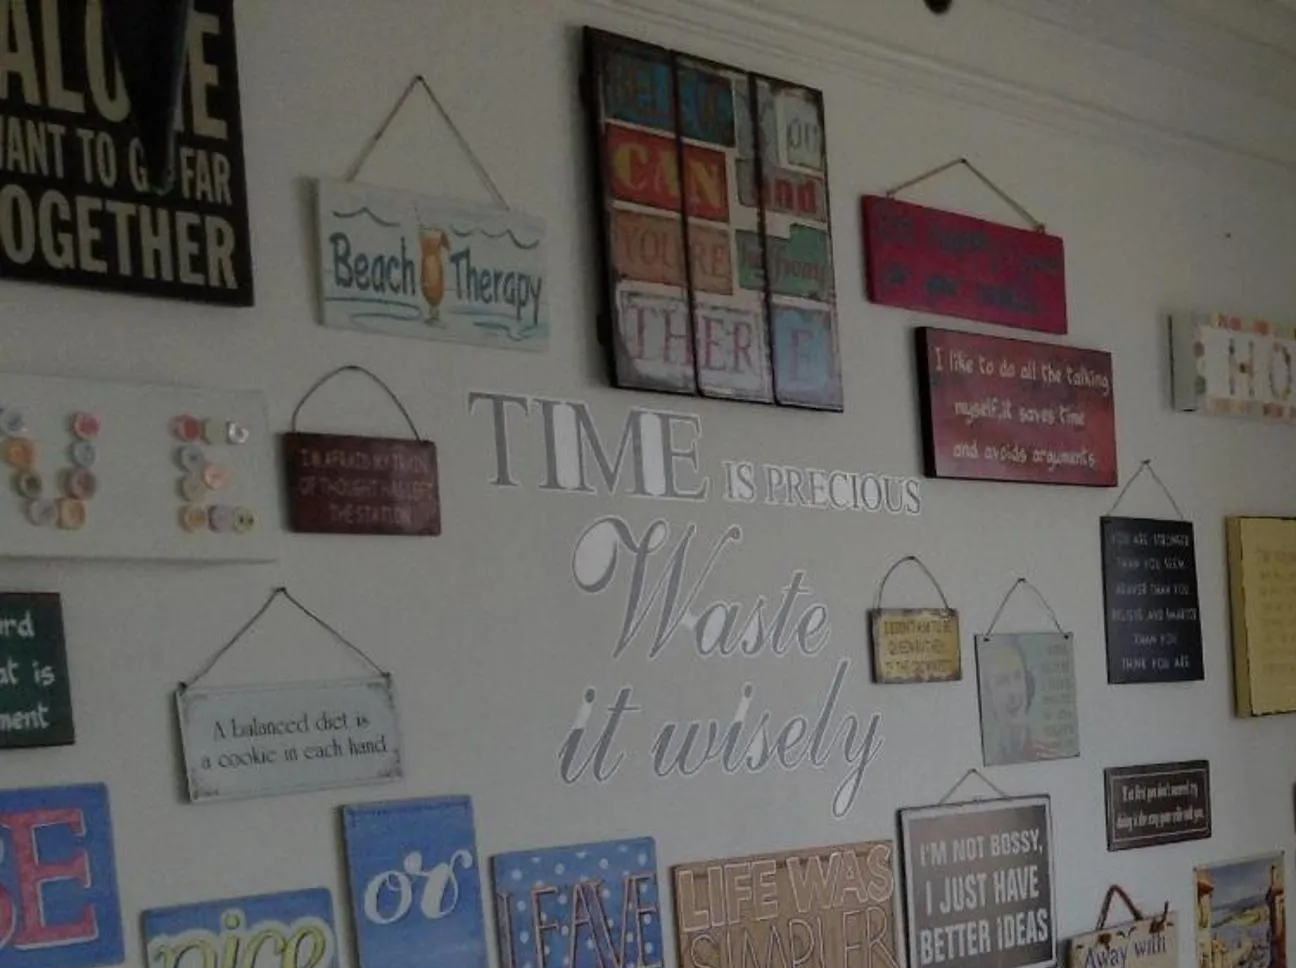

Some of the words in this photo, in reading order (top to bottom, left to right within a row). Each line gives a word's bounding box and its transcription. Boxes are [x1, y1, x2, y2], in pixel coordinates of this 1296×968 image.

[0, 0, 228, 141] ALOE
[0, 113, 66, 179] ANT
[76, 127, 118, 189] TO
[179, 146, 233, 206] FAR
[612, 142, 726, 212] CAN
[329, 232, 416, 297] Beach
[450, 247, 543, 326] Therapy
[934, 347, 944, 372] I
[949, 350, 974, 374] like
[978, 355, 995, 377] to
[1000, 359, 1016, 378] do
[1020, 360, 1037, 381] all
[1041, 364, 1062, 384] the
[1066, 365, 1112, 396] talking
[1018, 405, 1055, 426] saves
[1059, 405, 1086, 427] time
[467, 391, 710, 501] TIME
[721, 460, 755, 502] IS
[762, 463, 922, 515] PRECIOUS
[952, 440, 980, 460] and
[984, 442, 1028, 464] avoids
[1032, 446, 1097, 471] arguments
[571, 514, 832, 662] Waste
[32, 659, 55, 686] is
[201, 757, 212, 770] a
[217, 747, 277, 768] cookie
[284, 747, 299, 762] in
[303, 738, 343, 760] each
[348, 734, 387, 756] hand
[213, 720, 227, 741] A
[231, 713, 309, 738] balanced
[315, 711, 348, 731] diet
[356, 712, 371, 729] is
[558, 687, 642, 786] it
[650, 659, 885, 818] wisely
[0, 807, 99, 950] E
[919, 840, 948, 868] I'M
[952, 834, 986, 863] NOT
[363, 850, 474, 925] or
[678, 858, 779, 933] LIFE
[784, 843, 895, 914] WAS
[925, 880, 933, 917] I
[939, 872, 988, 915] JUST
[993, 864, 1040, 905] HAVE
[918, 919, 992, 967] BETTER
[996, 907, 1050, 952] IDEAS
[1134, 932, 1168, 958] with
